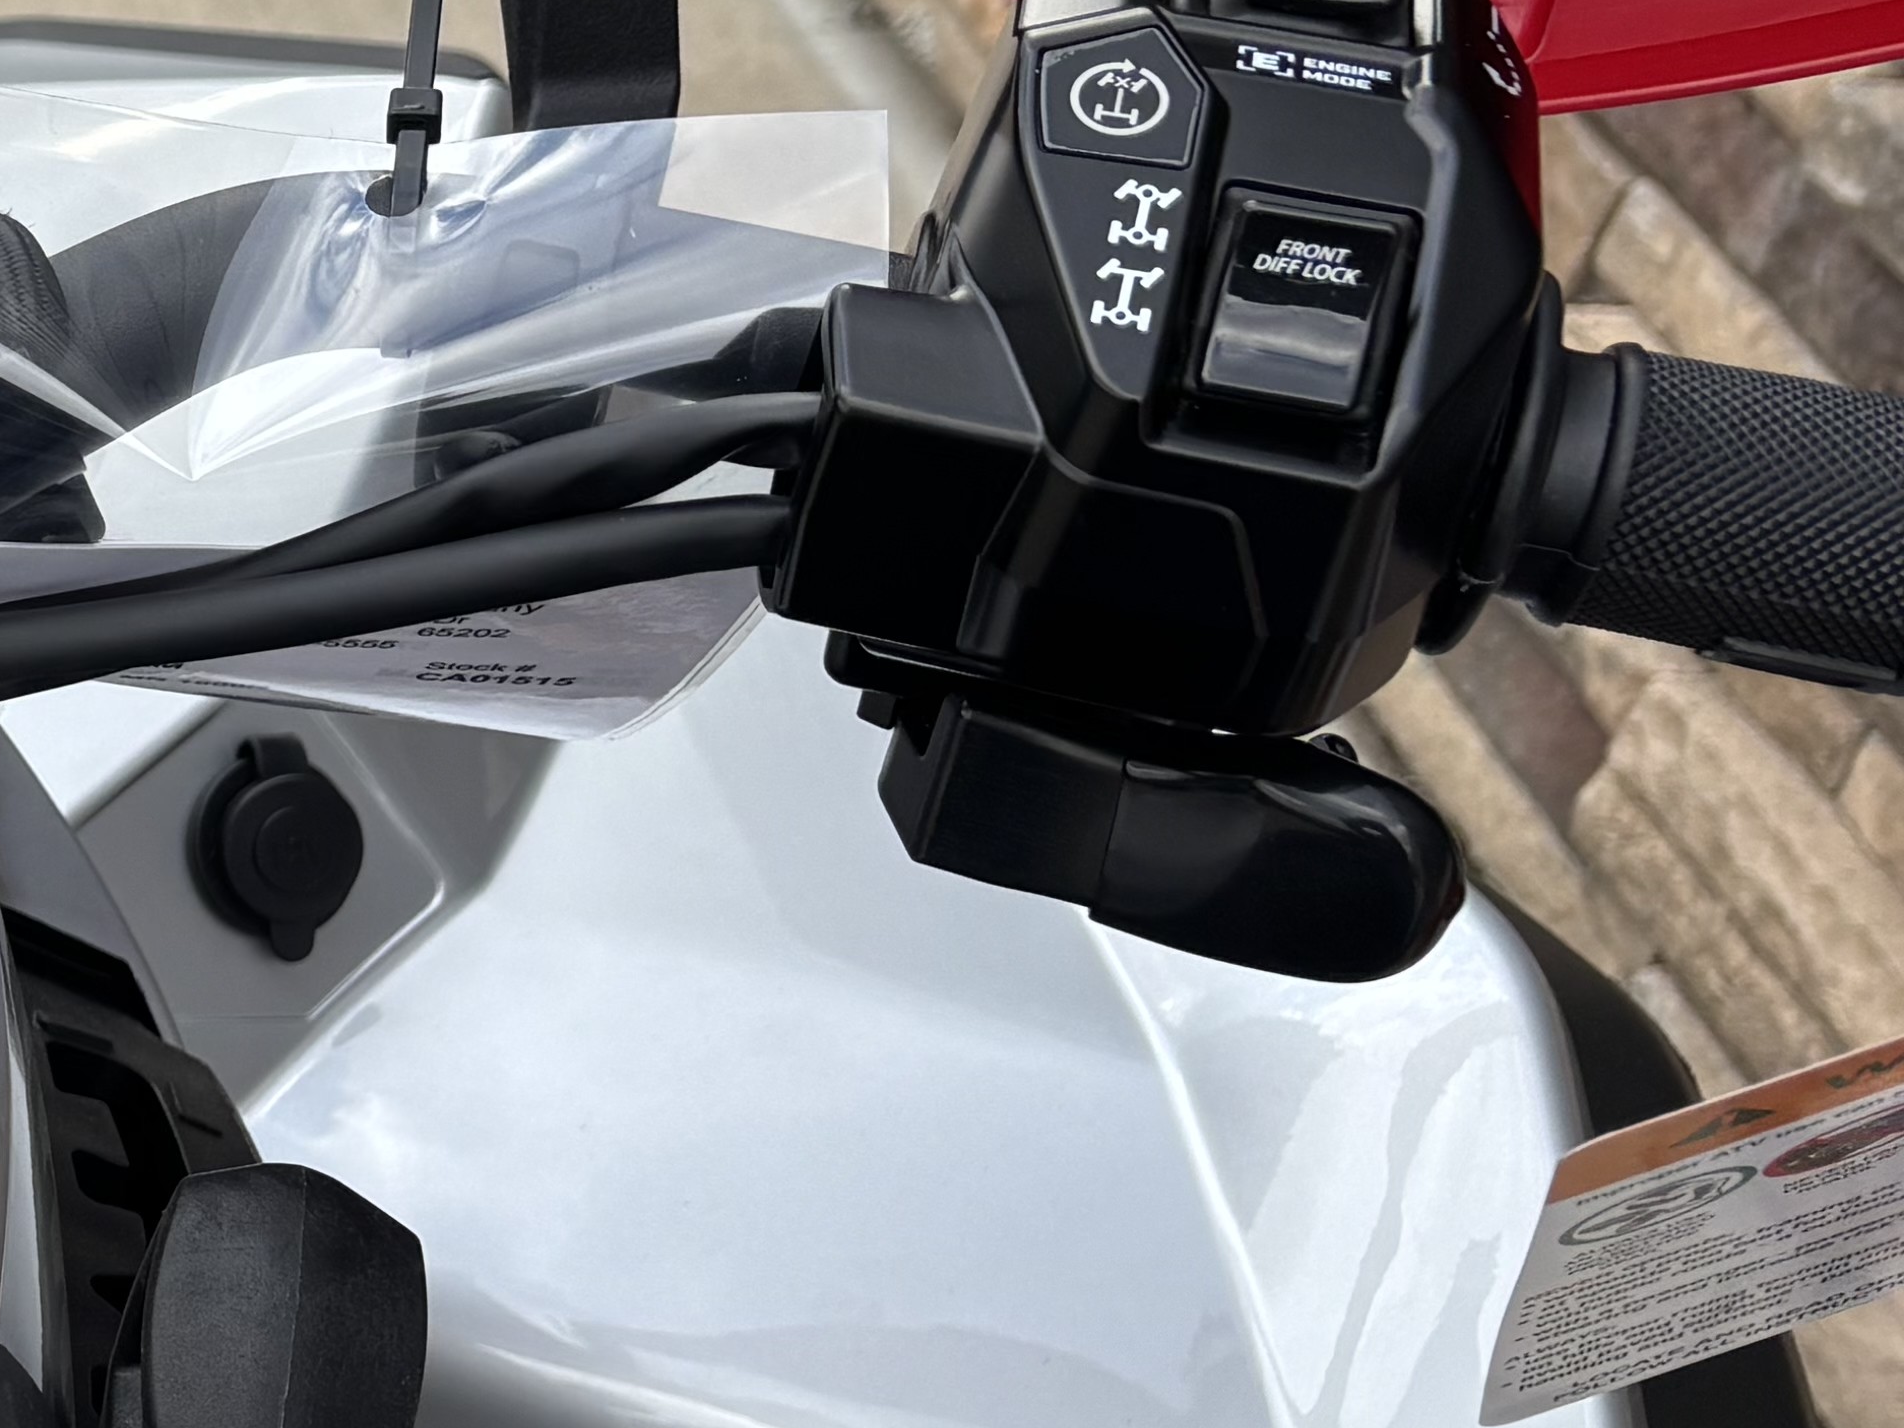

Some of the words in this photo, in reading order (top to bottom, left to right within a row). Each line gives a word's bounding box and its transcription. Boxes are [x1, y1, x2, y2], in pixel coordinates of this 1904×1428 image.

[1303, 57, 1392, 81] ENGINE
[1302, 70, 1373, 90] MODE
[1276, 238, 1352, 263] FRONT
[1253, 253, 1303, 274] DIFF
[1302, 262, 1362, 285] LOCK
[417, 627, 511, 638] 65202
[425, 661, 507, 672] Stock
[416, 672, 577, 686] CA01515
